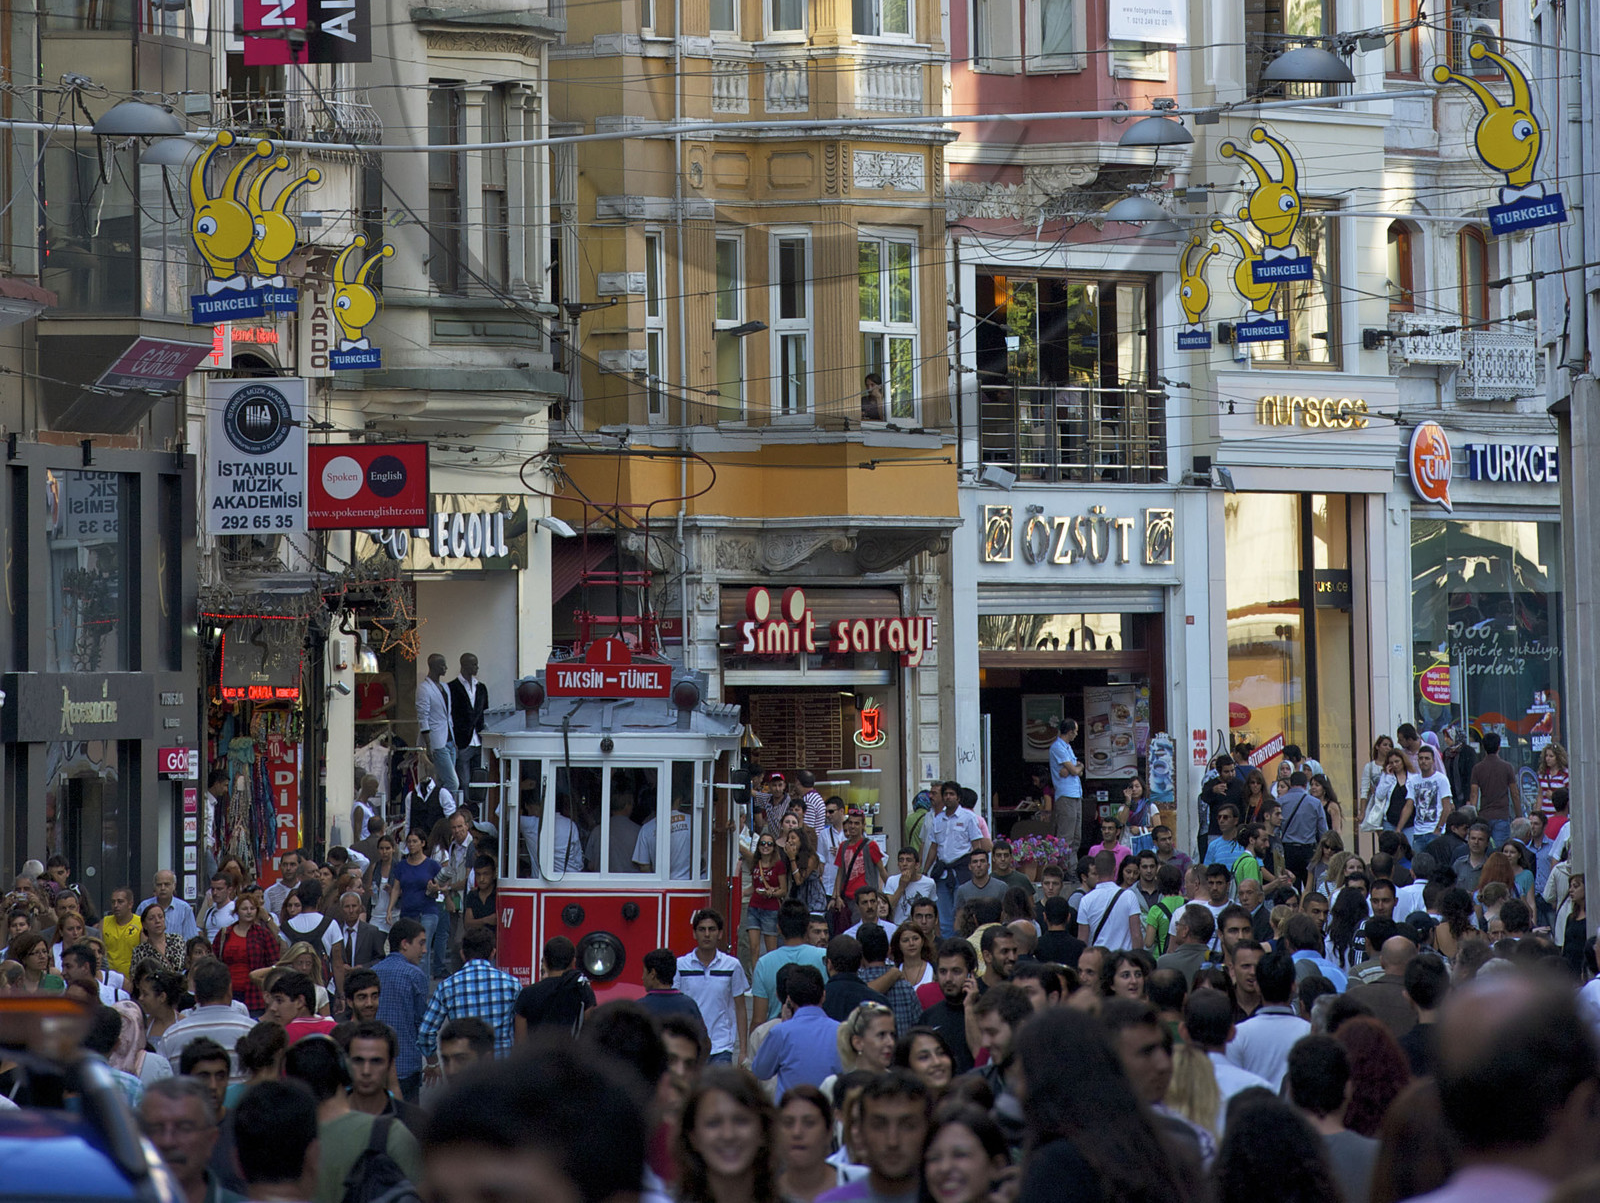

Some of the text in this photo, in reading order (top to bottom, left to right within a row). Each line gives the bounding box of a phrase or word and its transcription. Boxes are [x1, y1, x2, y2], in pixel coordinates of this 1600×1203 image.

[1496, 203, 1558, 225] TURKCELL
[1257, 264, 1308, 277] TURKCELL
[199, 296, 259, 314] TURKCELL
[263, 293, 292, 304] KCELL
[1180, 336, 1208, 345] TURKCELL
[1241, 326, 1285, 337] TURKCELL
[334, 354, 377, 365] TURKCELL
[218, 460, 298, 476] İSTANBUL
[1471, 444, 1558, 482] TURKCE
[232, 475, 283, 493] MÜZİK
[327, 471, 403, 484] Spoken English
[212, 492, 302, 510] AKADEMİSİ
[221, 514, 293, 529] 292 65 35
[307, 506, 425, 519] www.spokenenglishtr.com
[1022, 505, 1135, 564] ÖZSÜT
[736, 586, 933, 667] simit sarayı
[605, 641, 612, 662] 1
[1464, 657, 1525, 675] erden?
[619, 669, 663, 690] TÜNEL
[501, 908, 514, 928] 47
